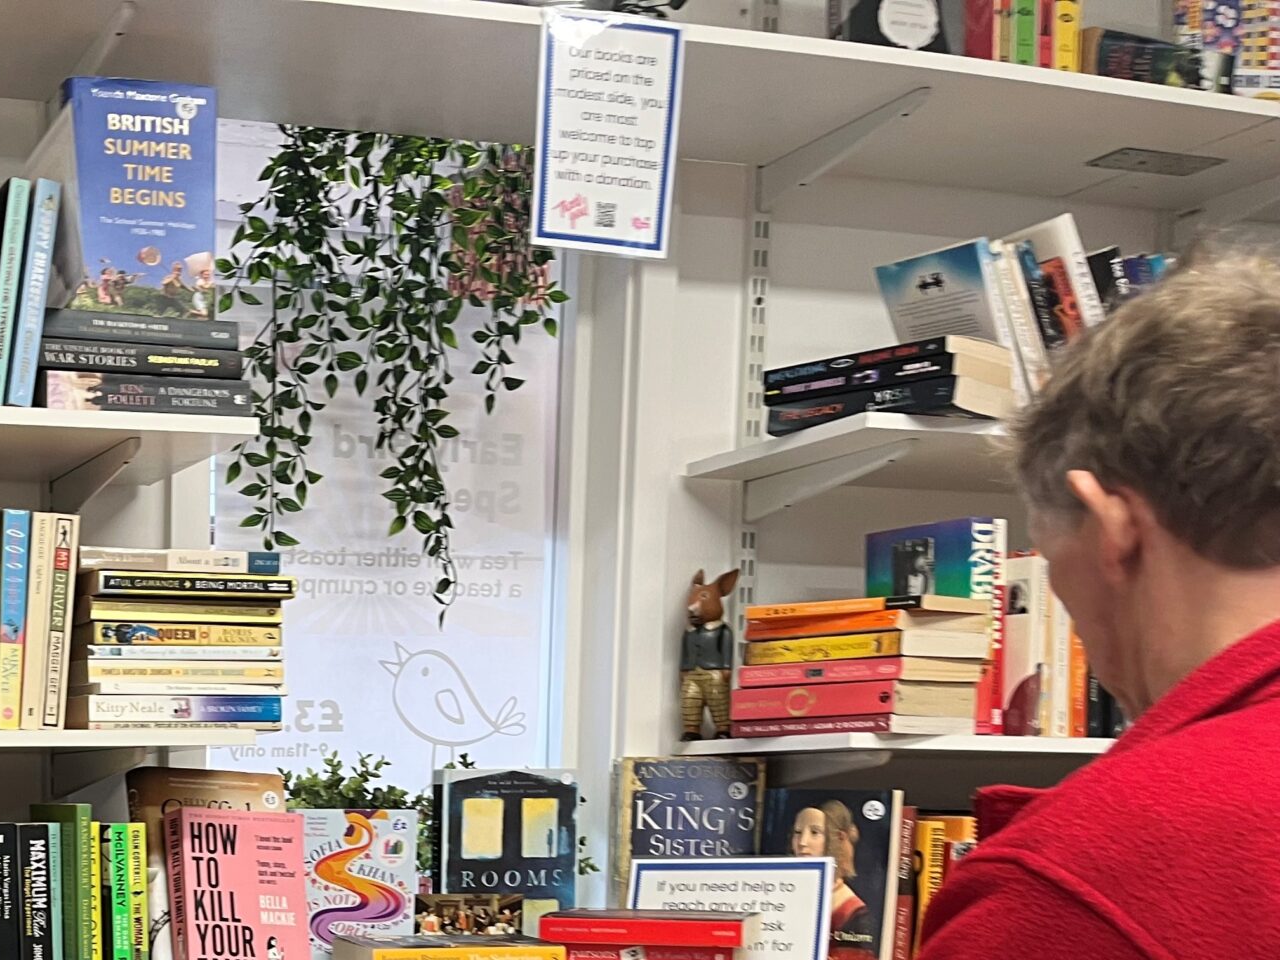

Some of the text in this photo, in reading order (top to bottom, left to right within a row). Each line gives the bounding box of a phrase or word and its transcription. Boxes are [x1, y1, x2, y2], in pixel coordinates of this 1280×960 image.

[570, 46, 657, 66] Our books are
[570, 67, 654, 86] priced on the
[555, 88, 604, 100] modest
[642, 98, 664, 110] you
[107, 113, 189, 136] BRITISH
[581, 111, 638, 126] are most
[104, 139, 192, 160] SUMMER
[559, 129, 656, 151] welcome to top
[552, 150, 658, 170] up your purchase
[123, 164, 173, 182] TIME
[555, 169, 582, 182] with
[585, 173, 594, 183] a
[110, 188, 185, 208] BEGINS
[45, 351, 137, 367] WAR STORIES
[195, 581, 265, 590] BEING MORTAL
[96, 701, 165, 717] Kitty Neale
[190, 822, 237, 855] HOW
[30, 839, 47, 909] MAXIMUM
[192, 856, 219, 888] TO
[461, 869, 565, 888] ROOMS
[657, 880, 795, 896] If you need help to
[194, 890, 241, 923] KILL
[260, 895, 288, 910] BELLA
[662, 900, 785, 912] reach any of the
[260, 912, 296, 926] MACKIE
[760, 921, 784, 932] ask
[196, 924, 256, 957] YOUR
[772, 940, 793, 951] for
